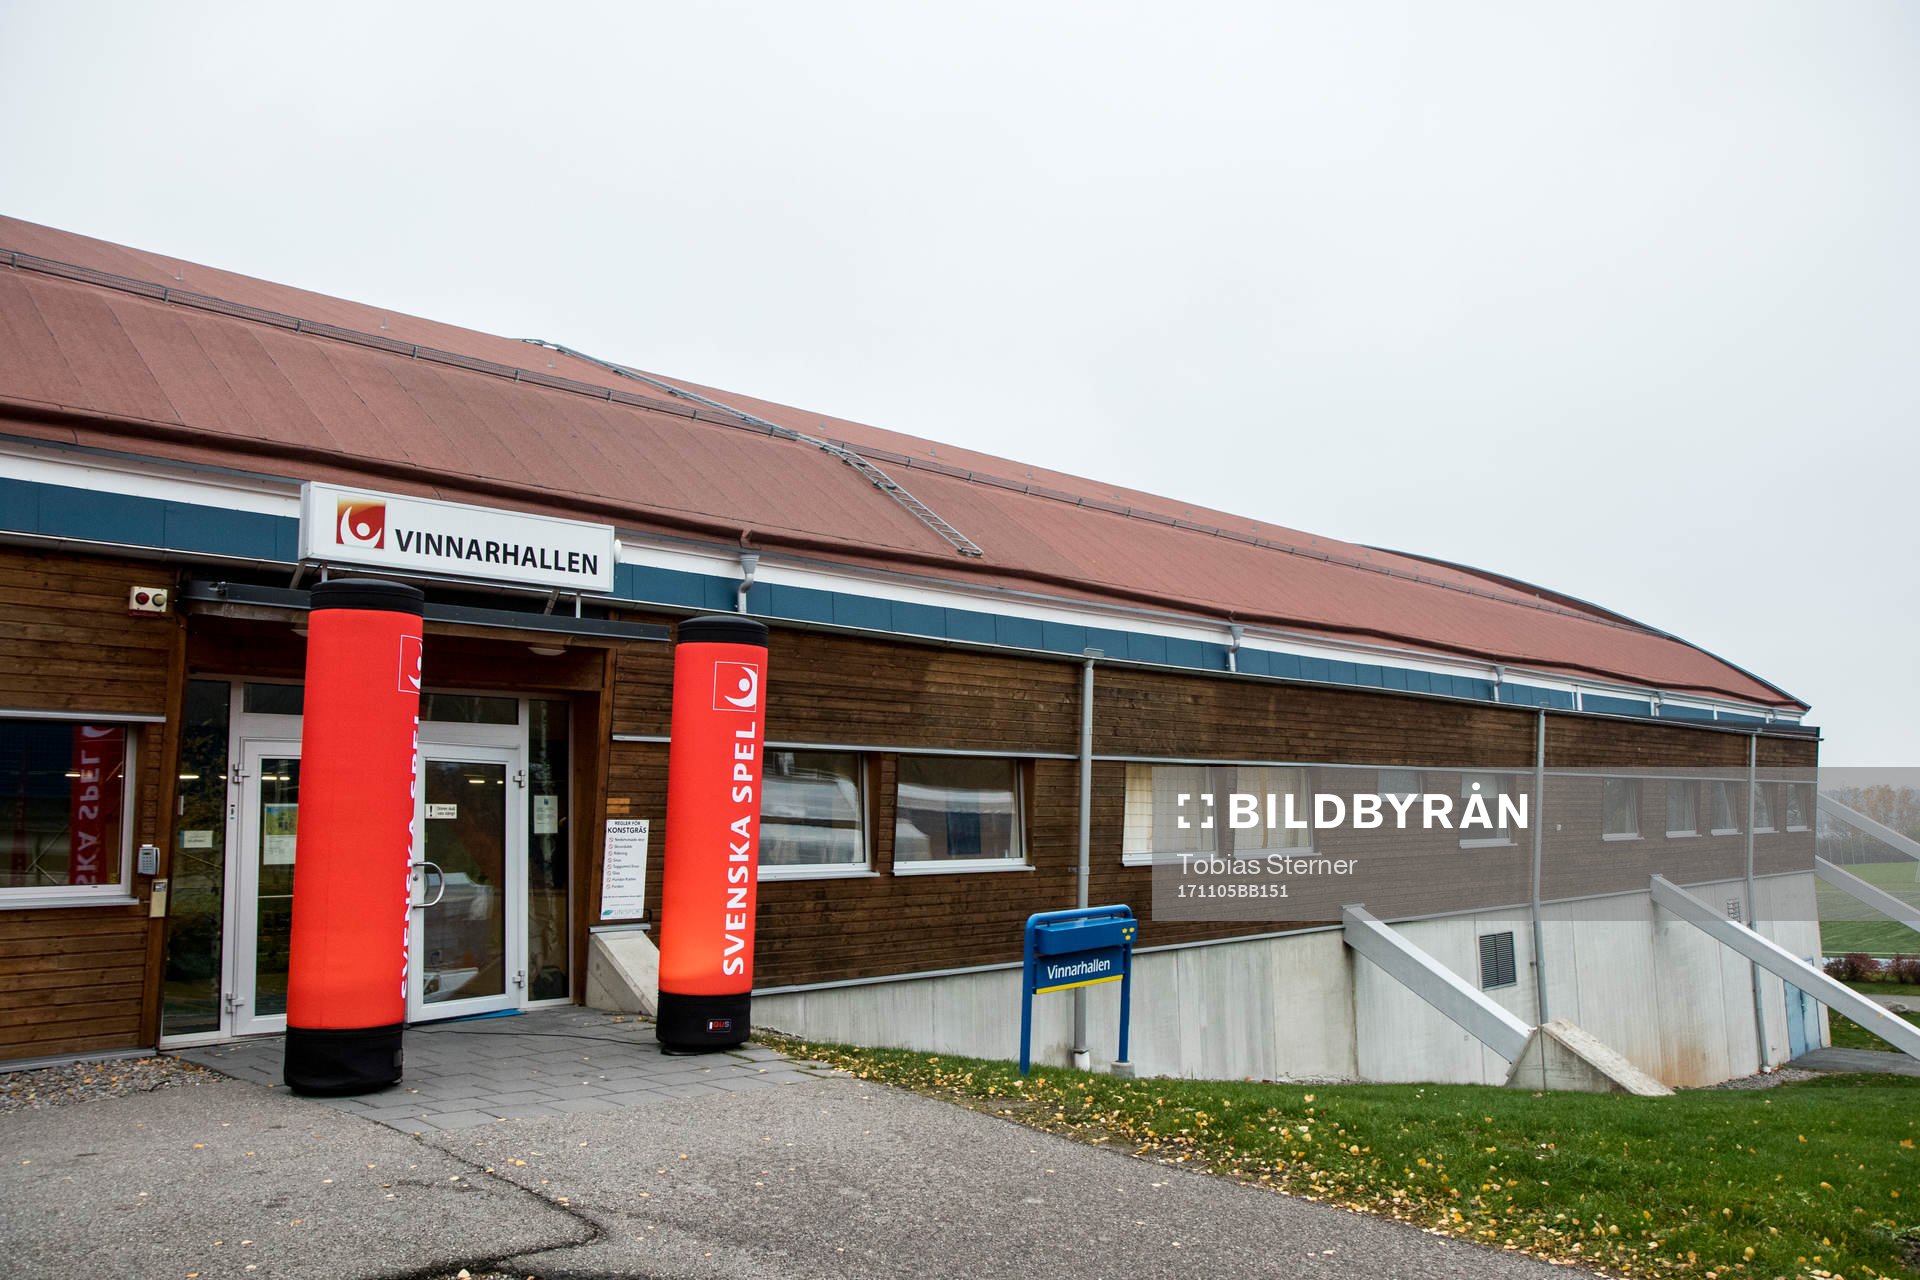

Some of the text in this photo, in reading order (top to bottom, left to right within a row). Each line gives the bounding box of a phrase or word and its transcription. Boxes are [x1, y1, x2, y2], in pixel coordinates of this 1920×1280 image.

[395, 528, 598, 575] VINNARHALLEN
[607, 826, 647, 834] KONSTGRÄS
[722, 721, 756, 976] SVENSKA SPEL
[1047, 958, 1111, 980] Vinnarhallen
